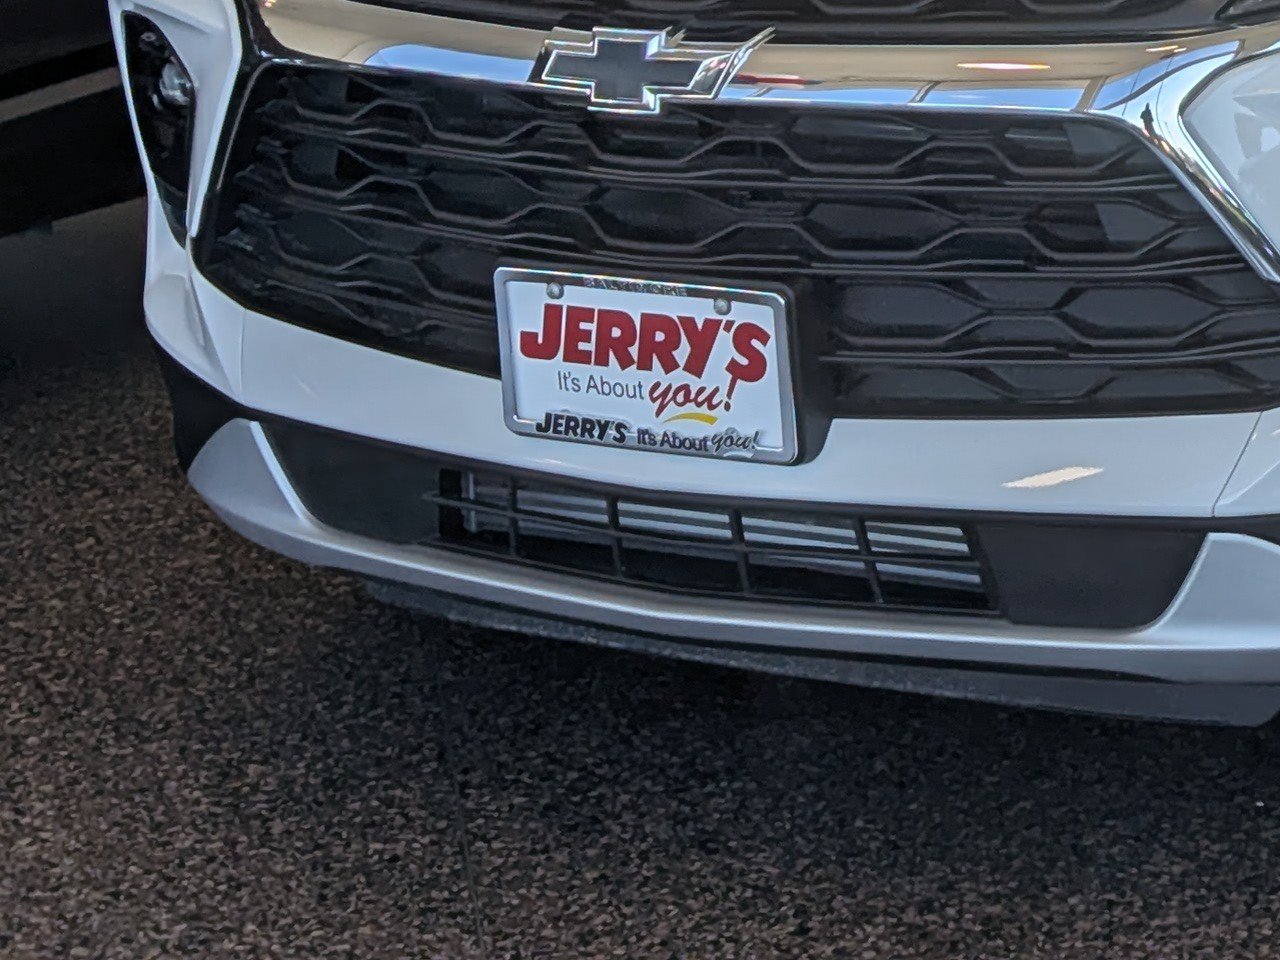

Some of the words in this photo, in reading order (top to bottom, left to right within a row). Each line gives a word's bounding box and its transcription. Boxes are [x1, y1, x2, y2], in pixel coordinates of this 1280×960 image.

[520, 302, 771, 383] JERRY'S
[558, 371, 580, 392] It's
[586, 375, 644, 400] About
[649, 377, 738, 418] you!
[536, 412, 628, 444] JERRY'S
[637, 426, 657, 446] It's
[660, 430, 709, 452] About
[711, 430, 760, 453] you!
